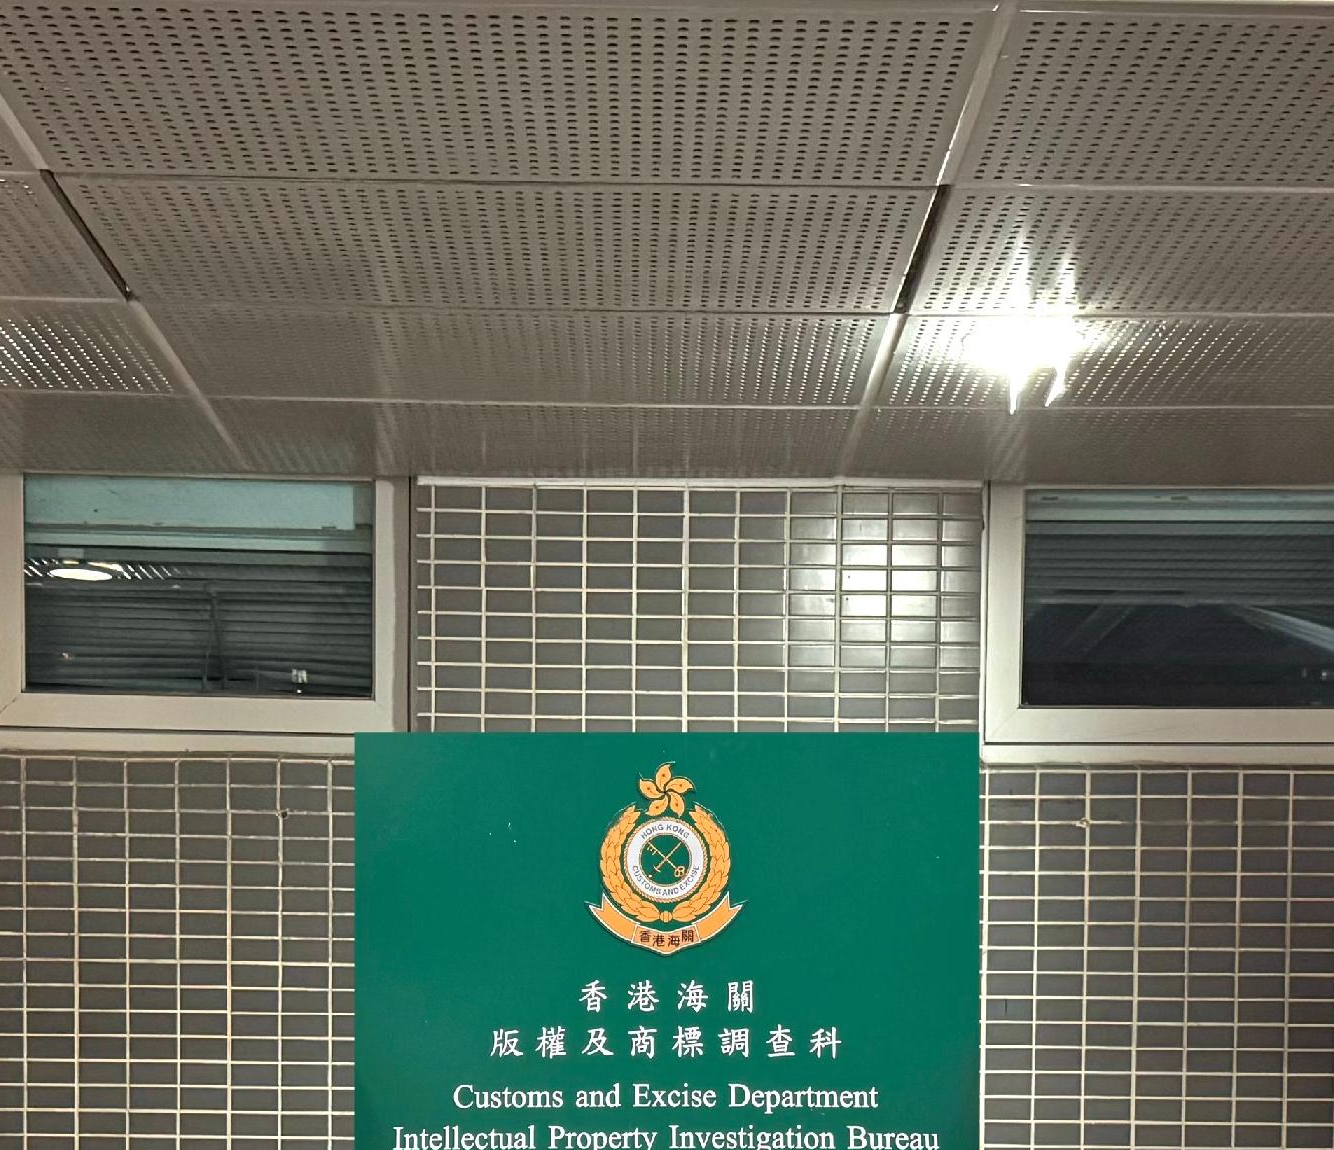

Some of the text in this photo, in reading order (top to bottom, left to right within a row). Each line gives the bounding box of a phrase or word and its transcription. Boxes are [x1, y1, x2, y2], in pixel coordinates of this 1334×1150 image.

[641, 824, 690, 839] HONG KONG
[632, 865, 701, 897] CUSTOMS AND EXCISE
[640, 929, 695, 948] 香港海關
[579, 979, 755, 1014] 香港海關
[490, 1026, 843, 1060] 版權及商標調查科
[453, 1083, 879, 1114] Customs and Excise Department
[392, 1125, 536, 1150] Intellectual
